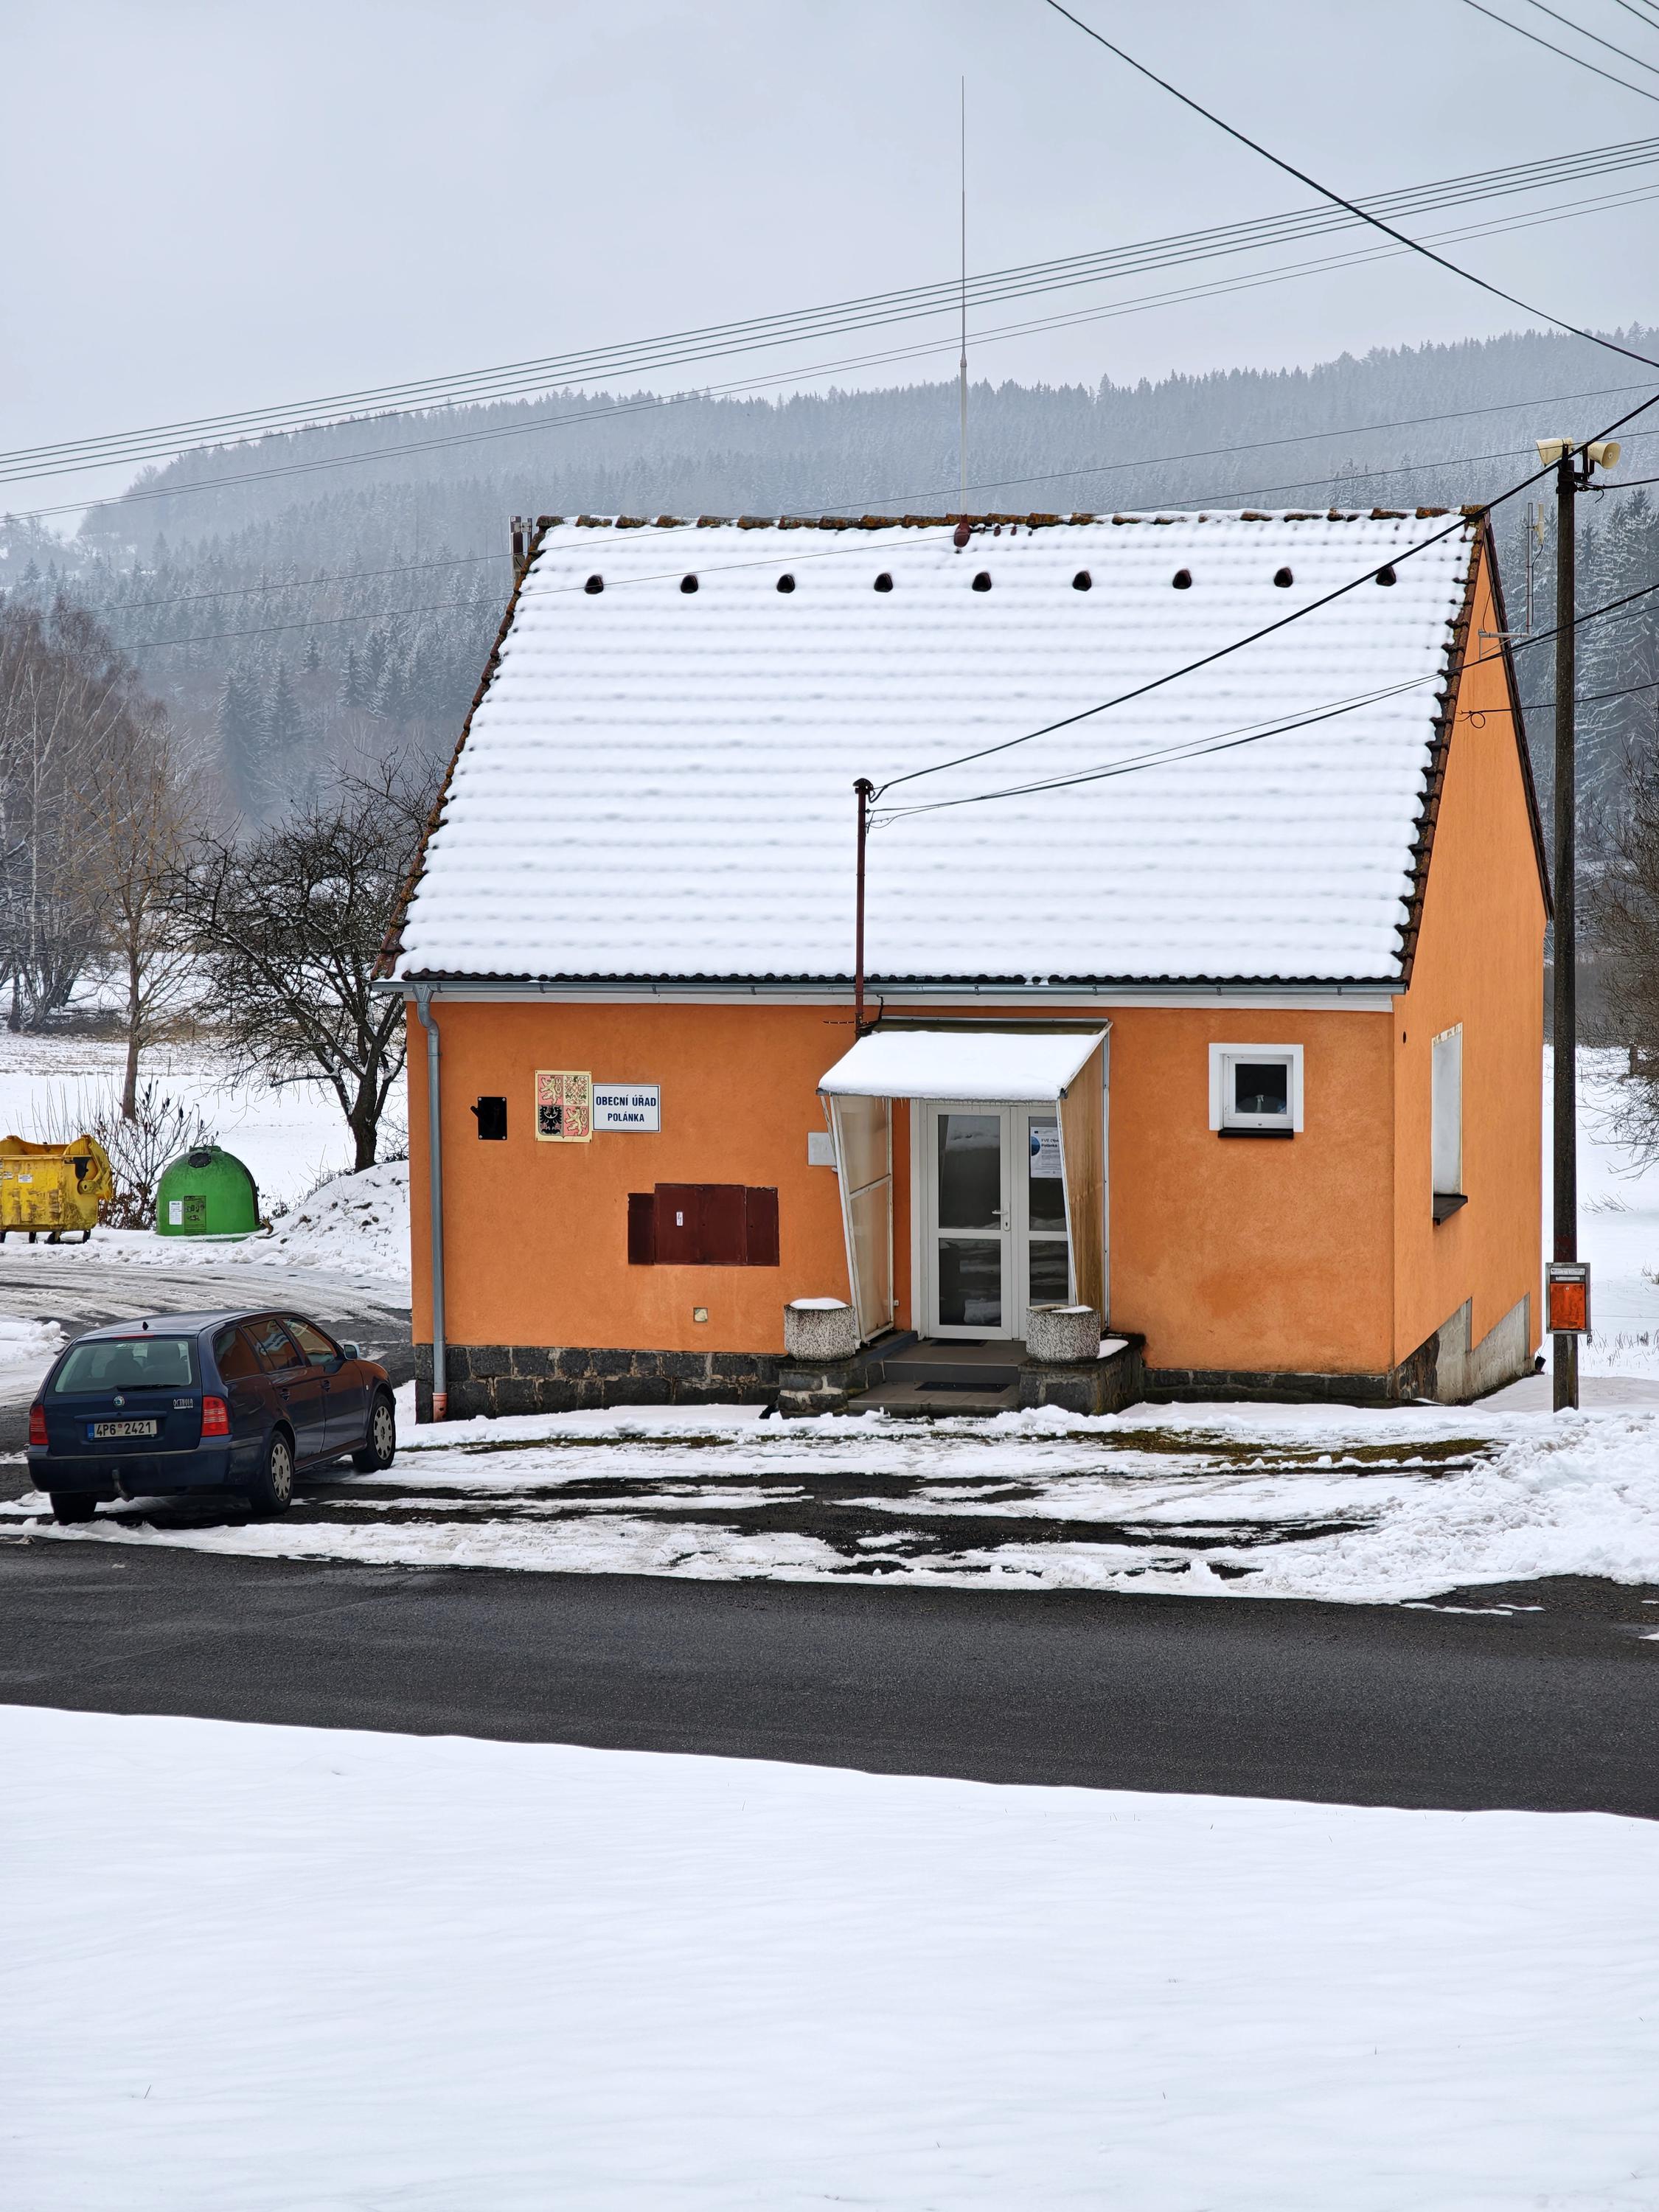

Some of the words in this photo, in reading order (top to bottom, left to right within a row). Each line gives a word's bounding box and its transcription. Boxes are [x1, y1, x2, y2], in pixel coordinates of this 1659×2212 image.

[596, 1094, 629, 1106] OBECNÍ
[632, 1094, 656, 1107] ÚŘAD
[608, 1111, 644, 1122] POLÁNKA
[96, 1424, 116, 1436] 4P6
[124, 1422, 151, 1435] 2421
